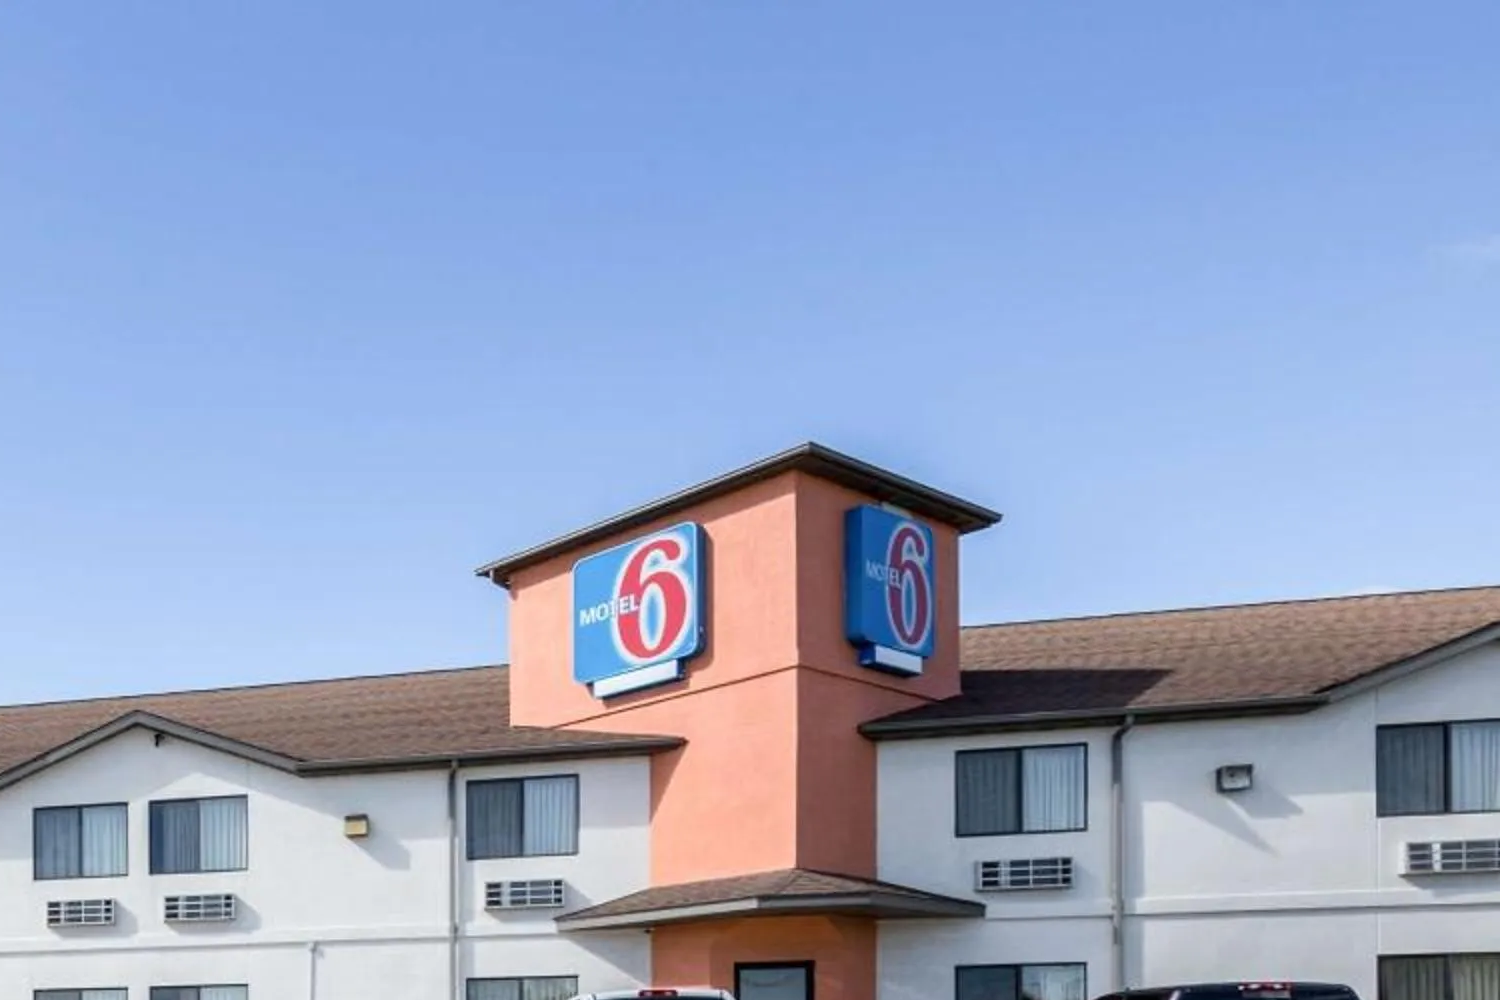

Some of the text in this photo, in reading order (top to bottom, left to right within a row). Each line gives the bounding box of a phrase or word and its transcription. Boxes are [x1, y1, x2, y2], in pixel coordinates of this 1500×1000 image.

[579, 537, 688, 660] MOTEL 6
[865, 523, 930, 647] MOTEL 6
